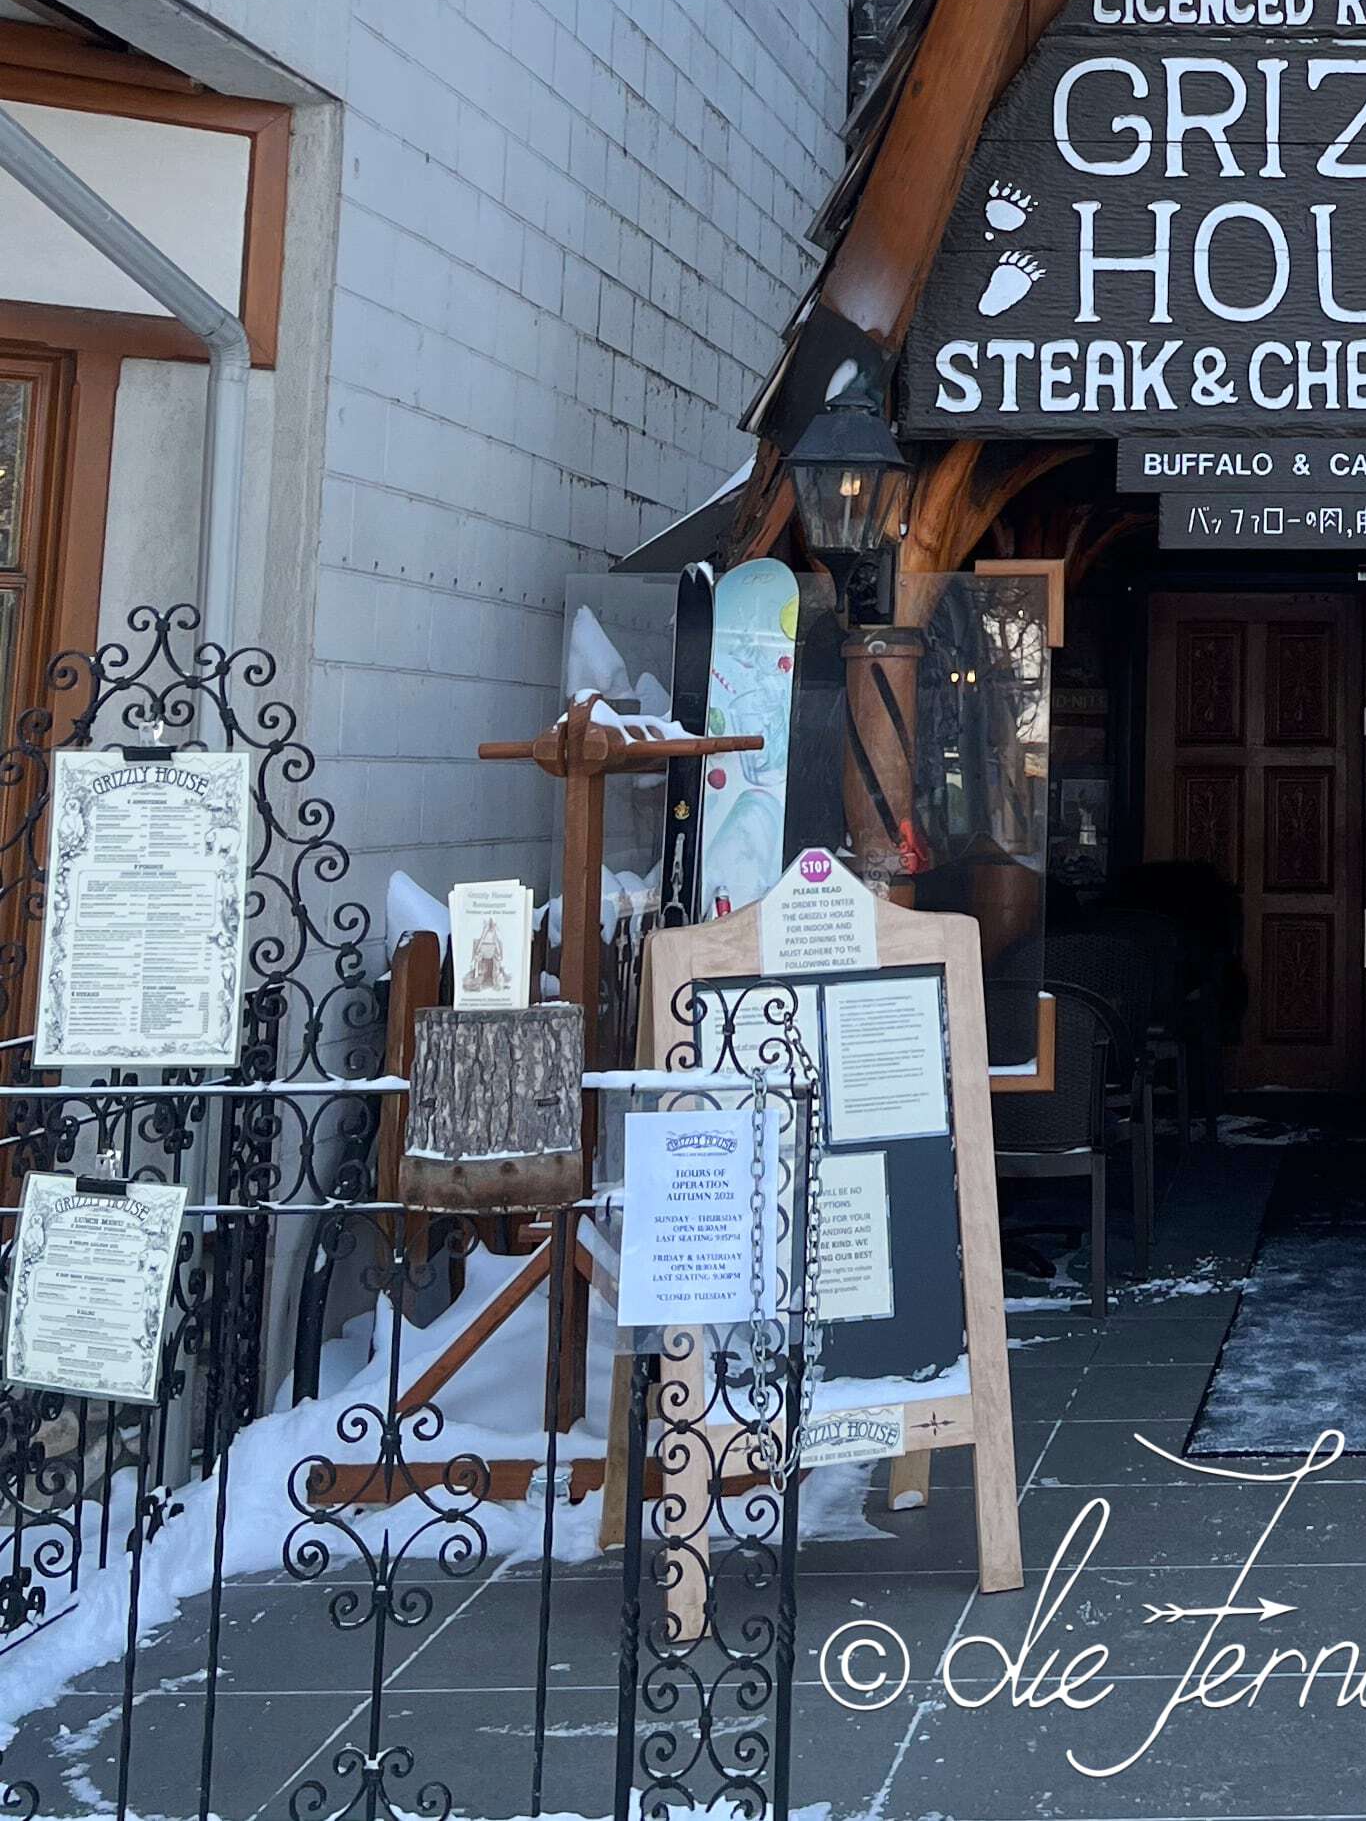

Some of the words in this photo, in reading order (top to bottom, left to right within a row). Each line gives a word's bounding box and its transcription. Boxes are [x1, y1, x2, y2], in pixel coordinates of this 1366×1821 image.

[934, 338, 1181, 413] STEAK
[1191, 346, 1239, 406] &
[1143, 452, 1273, 476] BUFFALO
[1292, 453, 1311, 476] &
[93, 767, 150, 795] GRIZZLY
[156, 767, 210, 796] HOUSE
[802, 861, 830, 874] STOP
[793, 887, 819, 895] PLEASE
[792, 901, 817, 909] ORDER
[831, 898, 855, 906] ENTER
[799, 912, 828, 921] GRIZZLY
[830, 910, 855, 918] HOUSE
[787, 925, 801, 933] FOR
[804, 924, 834, 932] INDOOR
[836, 922, 851, 930] AND
[803, 948, 833, 956] ADHERE
[835, 946, 846, 954] TO
[847, 945, 861, 953] THE
[785, 959, 830, 970] FOLLOWING
[677, 1169, 711, 1178] HOURS
[714, 1169, 726, 1177] OF
[672, 1181, 729, 1189] OPERATION
[667, 1193, 711, 1201] AUTUMN
[715, 1192, 735, 1200] 2021
[851, 1213, 871, 1221] YOUR
[656, 1235, 675, 1243] LAST
[679, 1234, 713, 1242] SEATING
[653, 1254, 684, 1262] FRIDAY
[697, 1253, 743, 1261] SATURDAY
[835, 1253, 852, 1261] OUR
[854, 1251, 872, 1259] BEST
[671, 1264, 693, 1272] OPEN
[653, 1274, 673, 1282] LAST
[675, 1273, 710, 1281] SEATING
[848, 1421, 898, 1447] HOUSE
